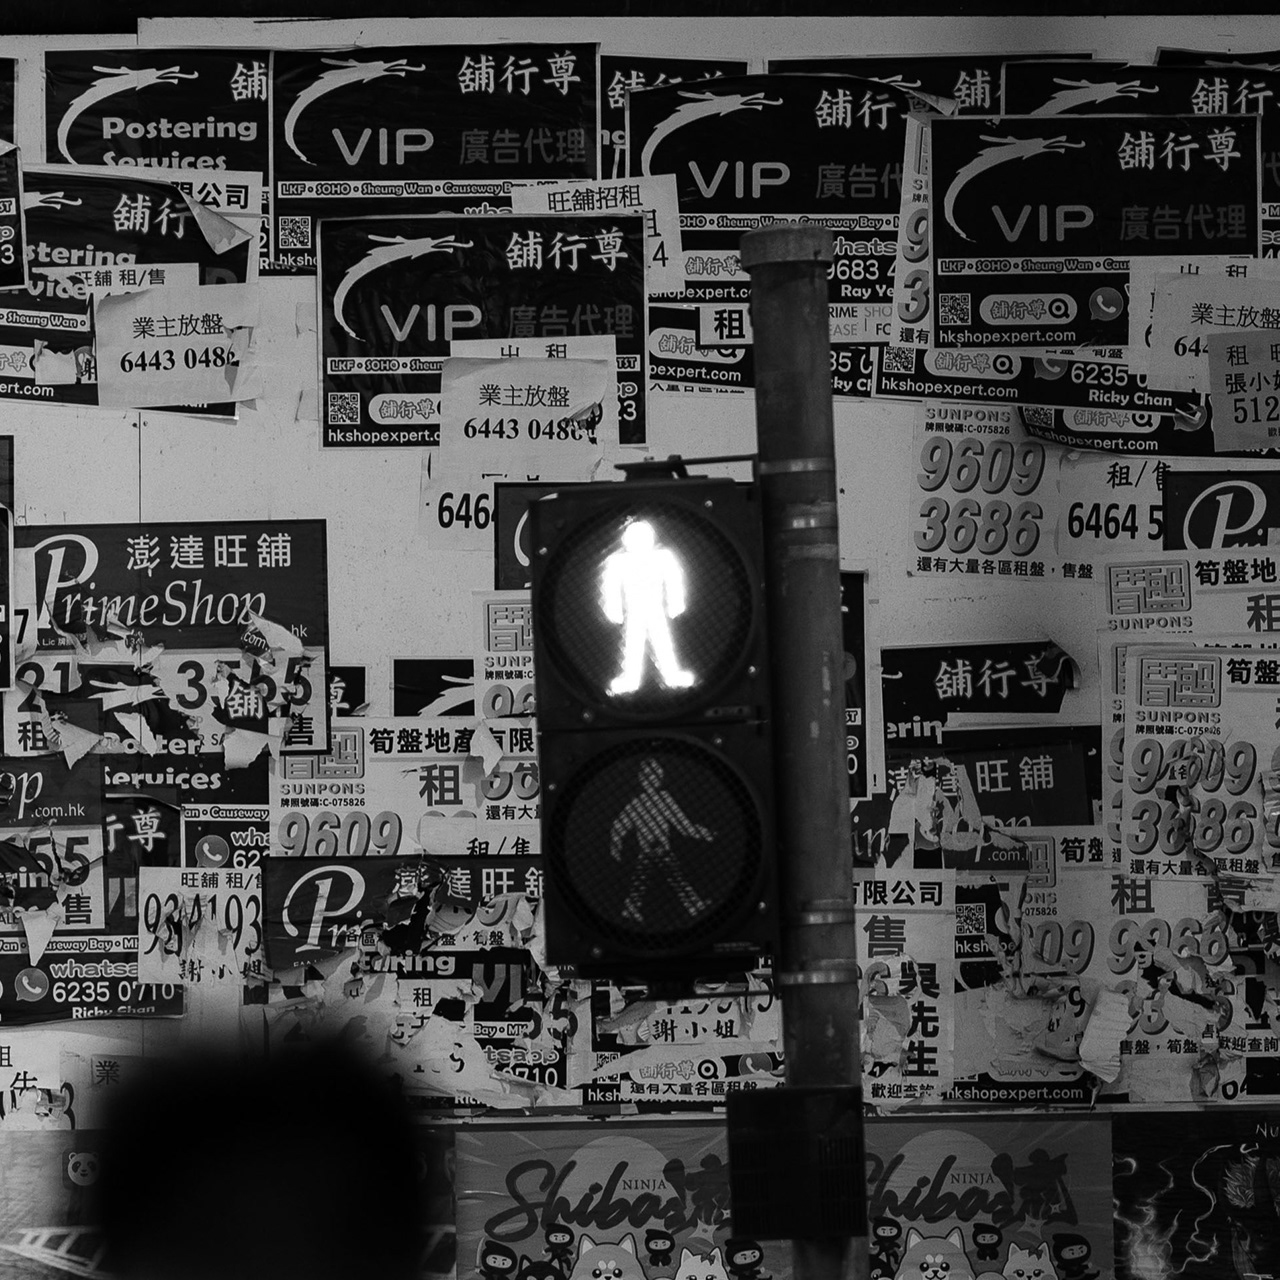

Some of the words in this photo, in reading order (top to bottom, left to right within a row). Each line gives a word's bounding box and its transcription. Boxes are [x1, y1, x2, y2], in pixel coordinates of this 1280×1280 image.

[458, 52, 582, 96] 舖行尊
[332, 128, 434, 165] VIP
[460, 129, 586, 165] 廣告代理
[1118, 129, 1241, 172] 舖行尊
[991, 205, 1093, 241] VIP
[1120, 205, 1247, 241] 廣告代理
[132, 314, 224, 338] 業主放盤
[940, 328, 1076, 345] hkshopexpert.com
[119, 349, 175, 372] 6443
[918, 436, 1046, 497] 9609
[914, 497, 1043, 557] 3686
[1068, 501, 1138, 540] 6464
[127, 532, 292, 575] 澎達旺舖
[653, 1018, 740, 1042] 謝小姐
[950, 1173, 995, 1185] NINJA
